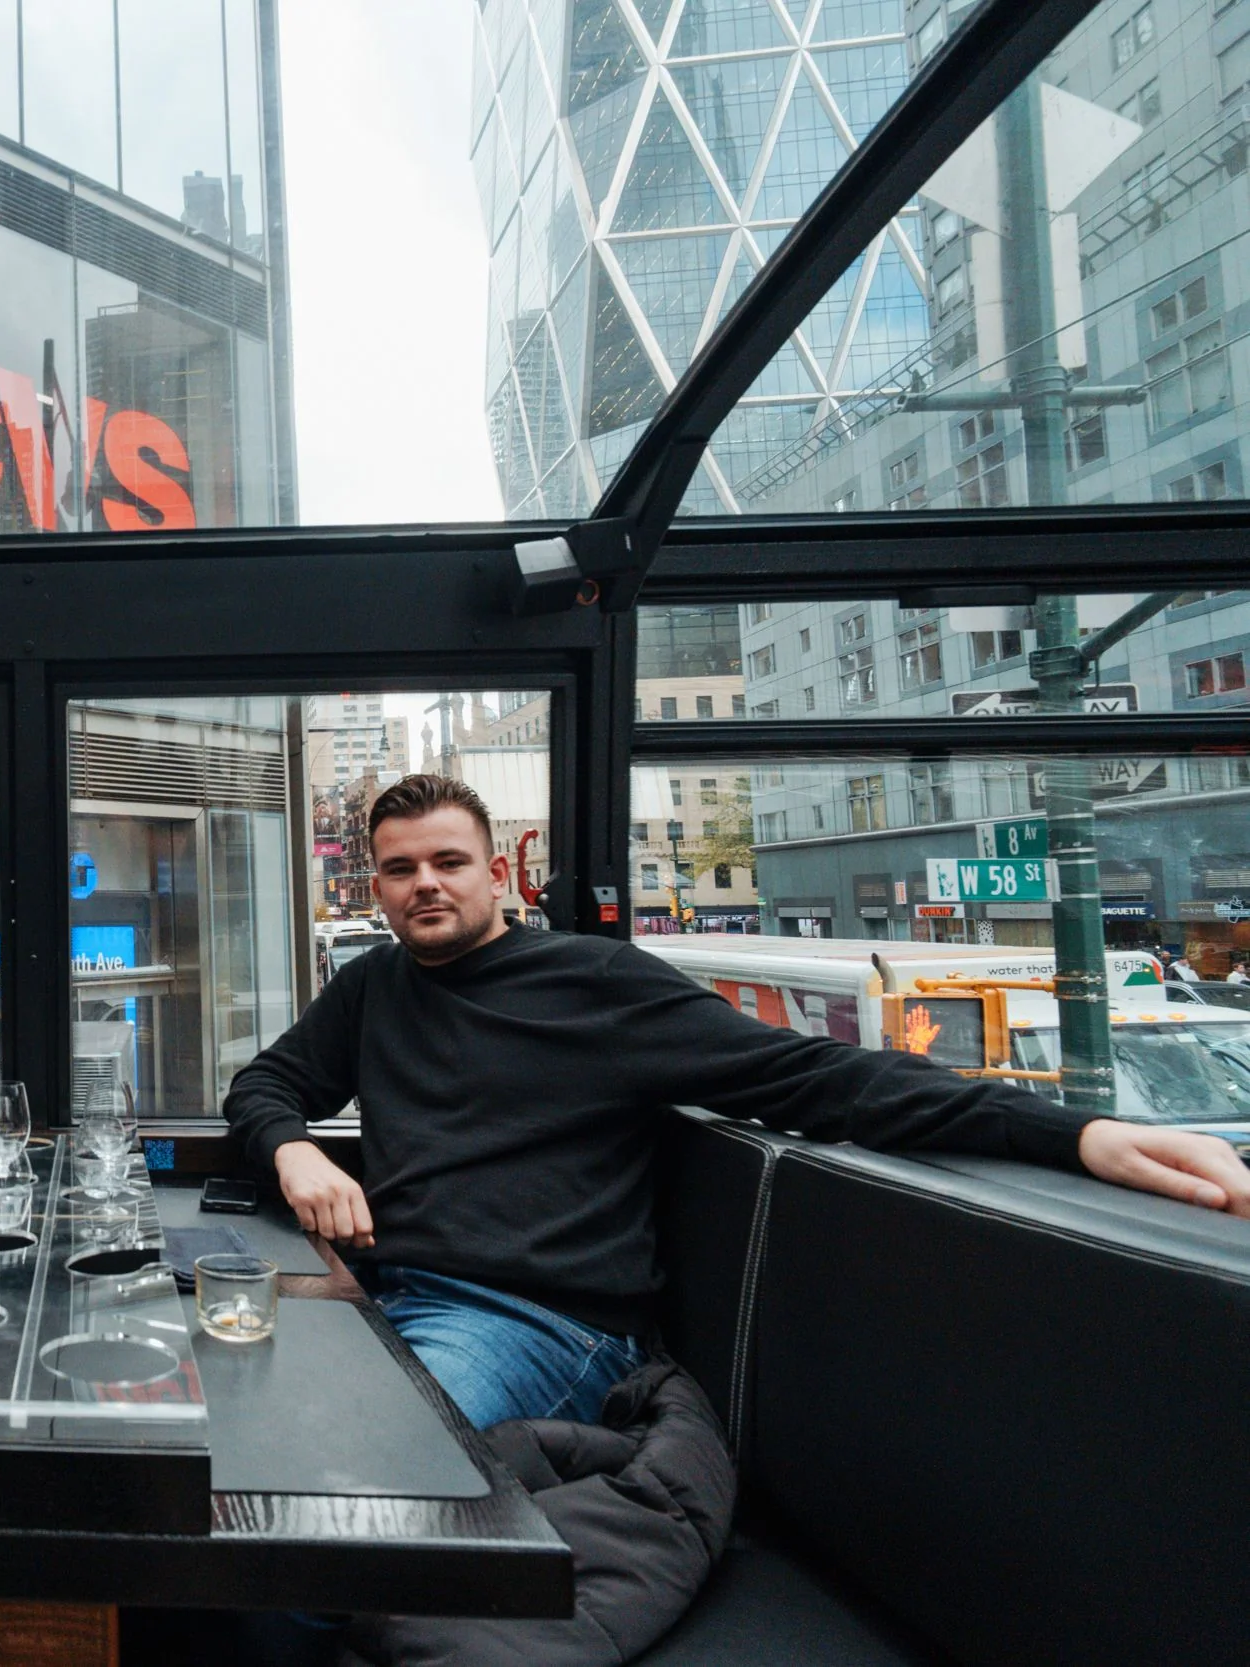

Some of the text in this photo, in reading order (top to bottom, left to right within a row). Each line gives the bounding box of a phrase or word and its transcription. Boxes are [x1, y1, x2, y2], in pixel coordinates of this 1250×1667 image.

[1008, 824, 1037, 855] 8 Av
[960, 863, 1041, 896] W 58 St
[1101, 907, 1146, 915] BAGUETTE
[95, 952, 127, 971] Ave.
[1113, 960, 1142, 972] 6475
[987, 964, 1054, 976] water that
